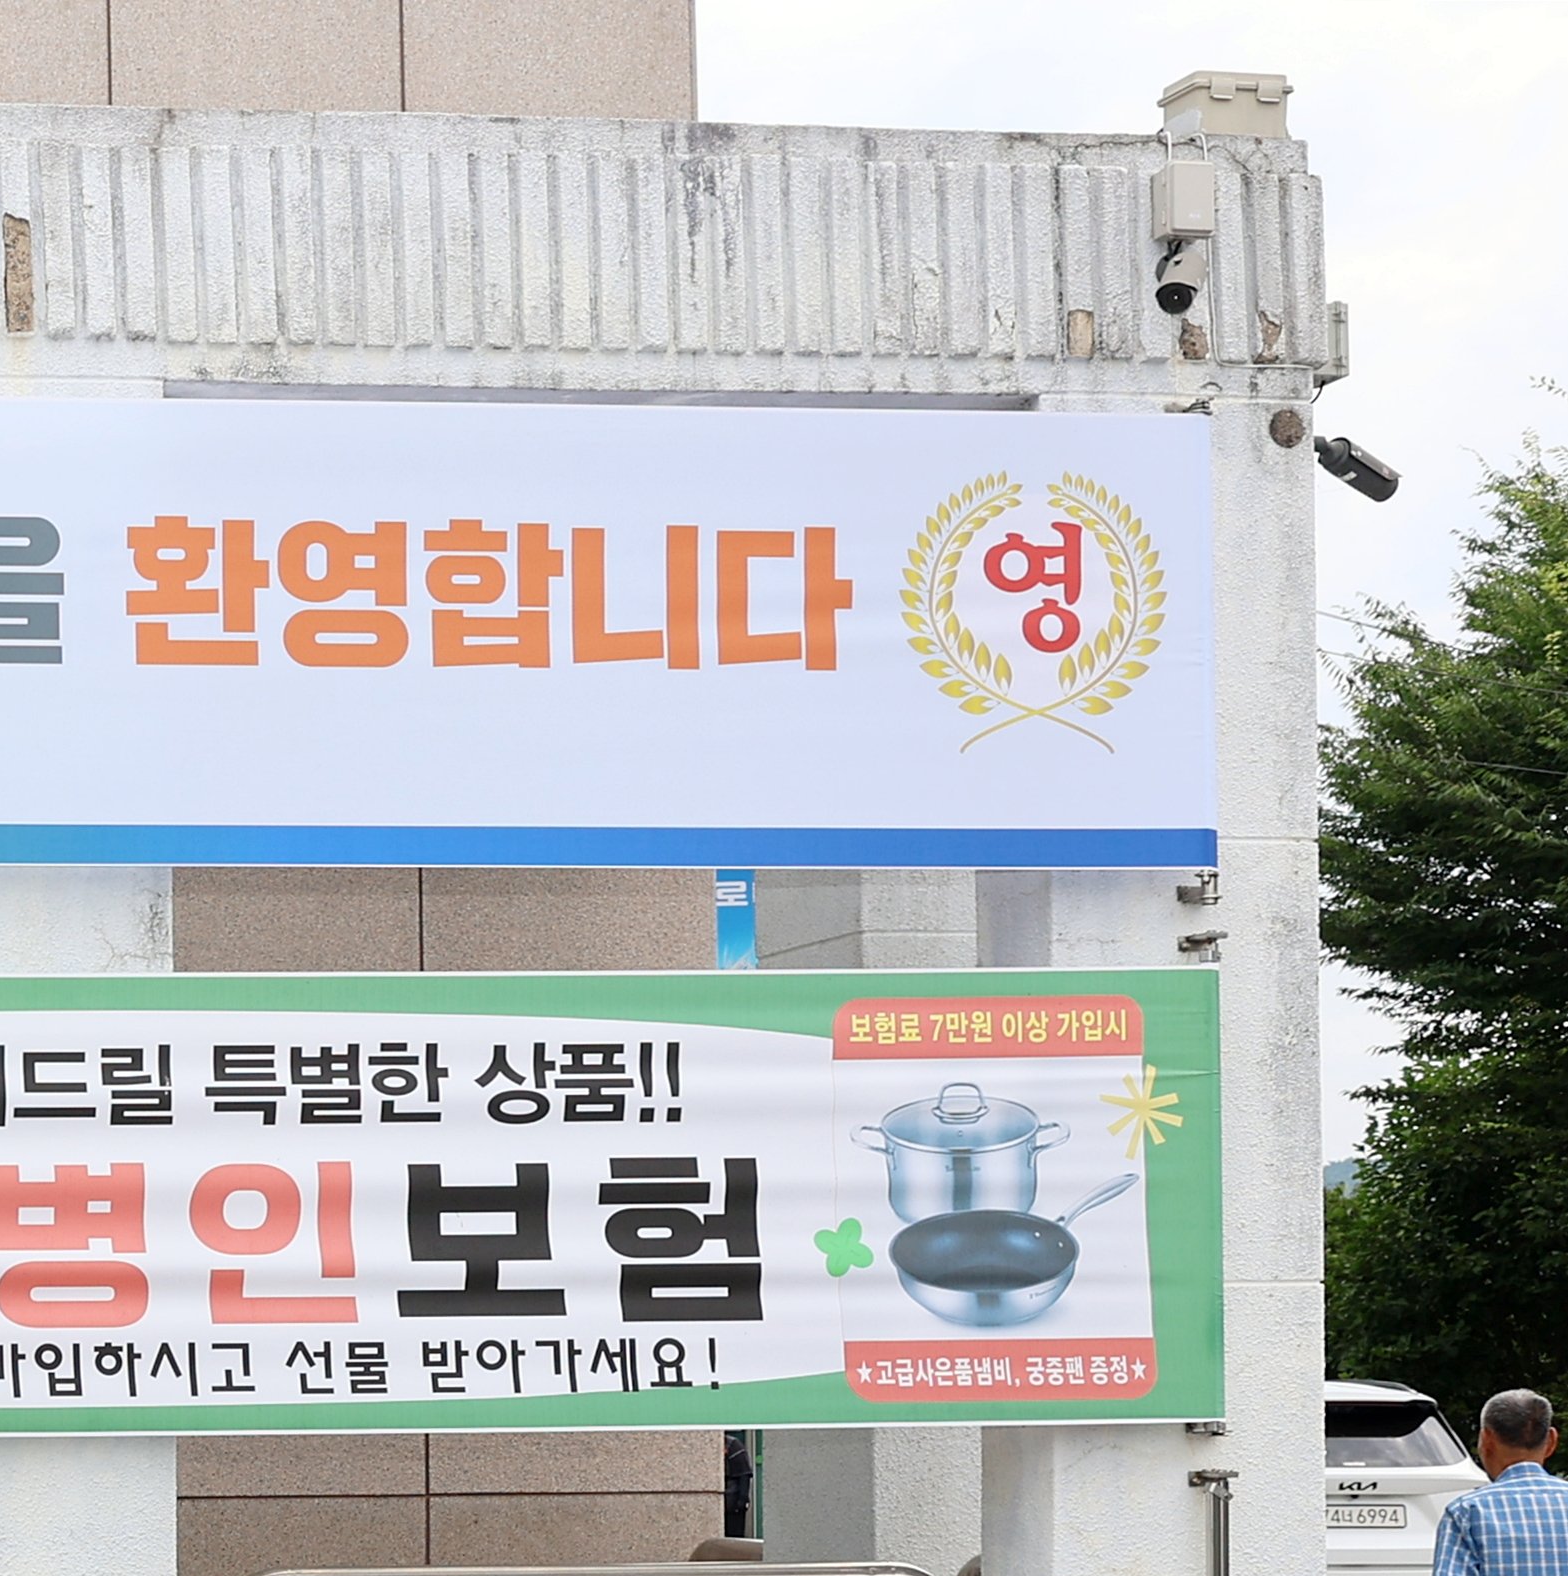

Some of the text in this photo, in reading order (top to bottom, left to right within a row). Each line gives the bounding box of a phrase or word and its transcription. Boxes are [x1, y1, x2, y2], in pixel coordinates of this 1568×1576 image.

[128, 517, 852, 670] 환영합니다
[982, 520, 1084, 653] 영
[850, 1010, 1125, 1043] 보험료 7만원 이상 가입시
[205, 1043, 448, 1125] 특별한
[475, 1042, 681, 1124] 상품!!
[286, 1342, 388, 1394] 선물
[423, 1338, 719, 1393] 받아가세요!
[1026, 1357, 1084, 1385] 궁중팬
[1090, 1356, 1128, 1384] 증정
[1338, 1481, 1378, 1491] KIA
[1356, 1508, 1399, 1524] 6994
